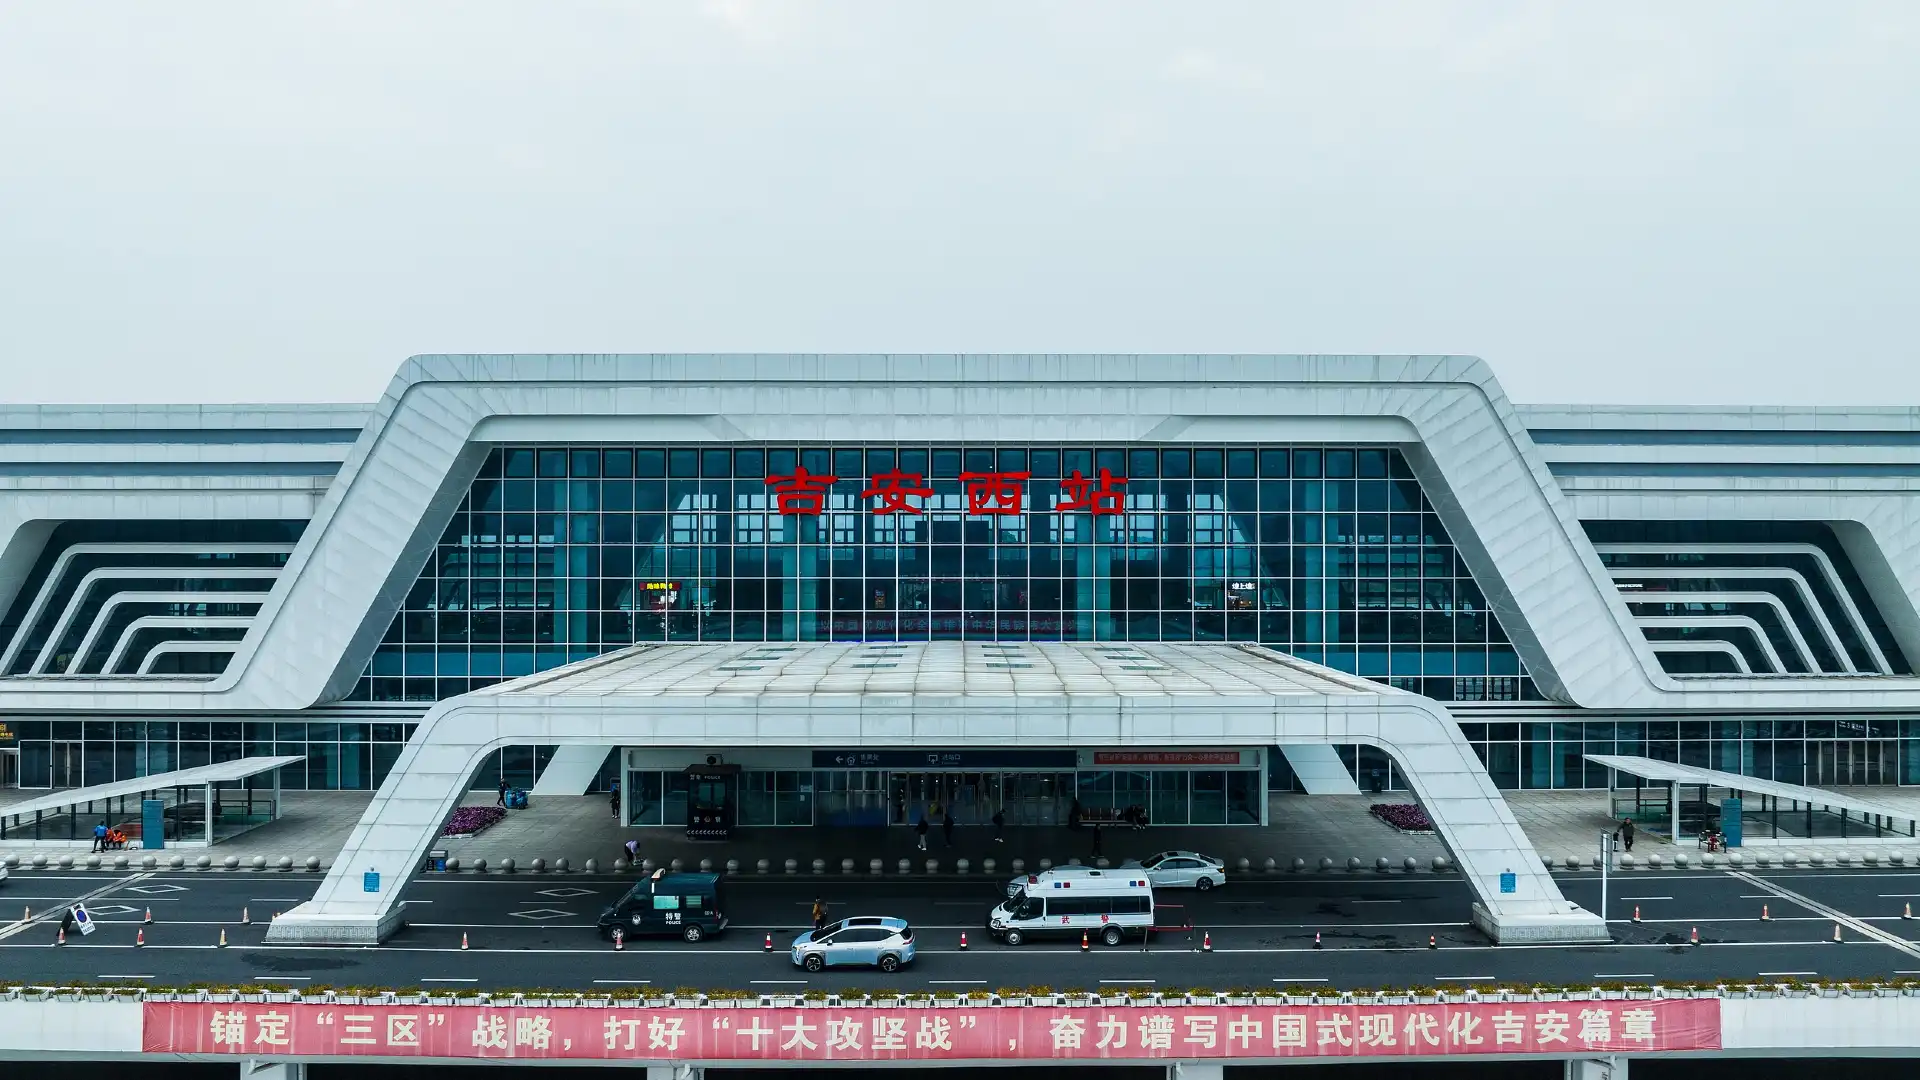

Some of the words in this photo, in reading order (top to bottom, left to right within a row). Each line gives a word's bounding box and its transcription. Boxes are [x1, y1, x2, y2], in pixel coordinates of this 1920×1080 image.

[764, 466, 1129, 516] 吉安西站
[665, 912, 682, 920] 特警
